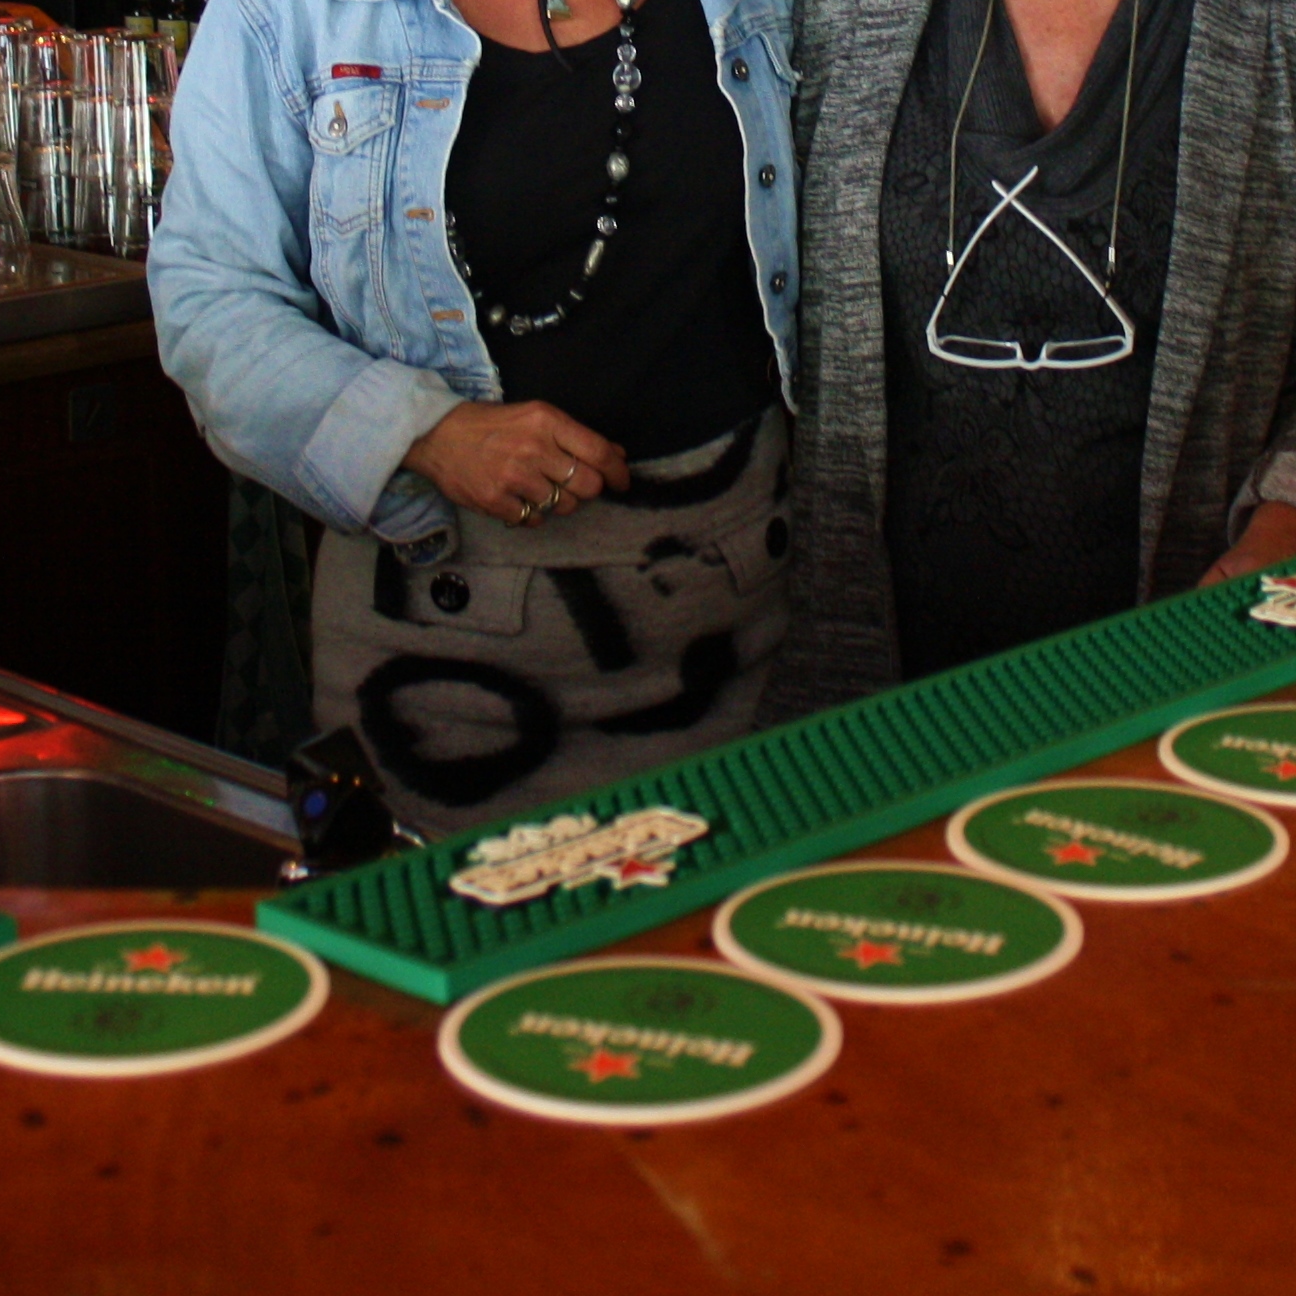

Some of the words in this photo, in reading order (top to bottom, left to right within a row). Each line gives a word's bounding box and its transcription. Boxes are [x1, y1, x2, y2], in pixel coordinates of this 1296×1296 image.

[1021, 806, 1205, 871] Heineken
[782, 906, 1007, 957] Heineken
[19, 965, 260, 998] Heineken
[515, 1009, 757, 1069] Heineken
